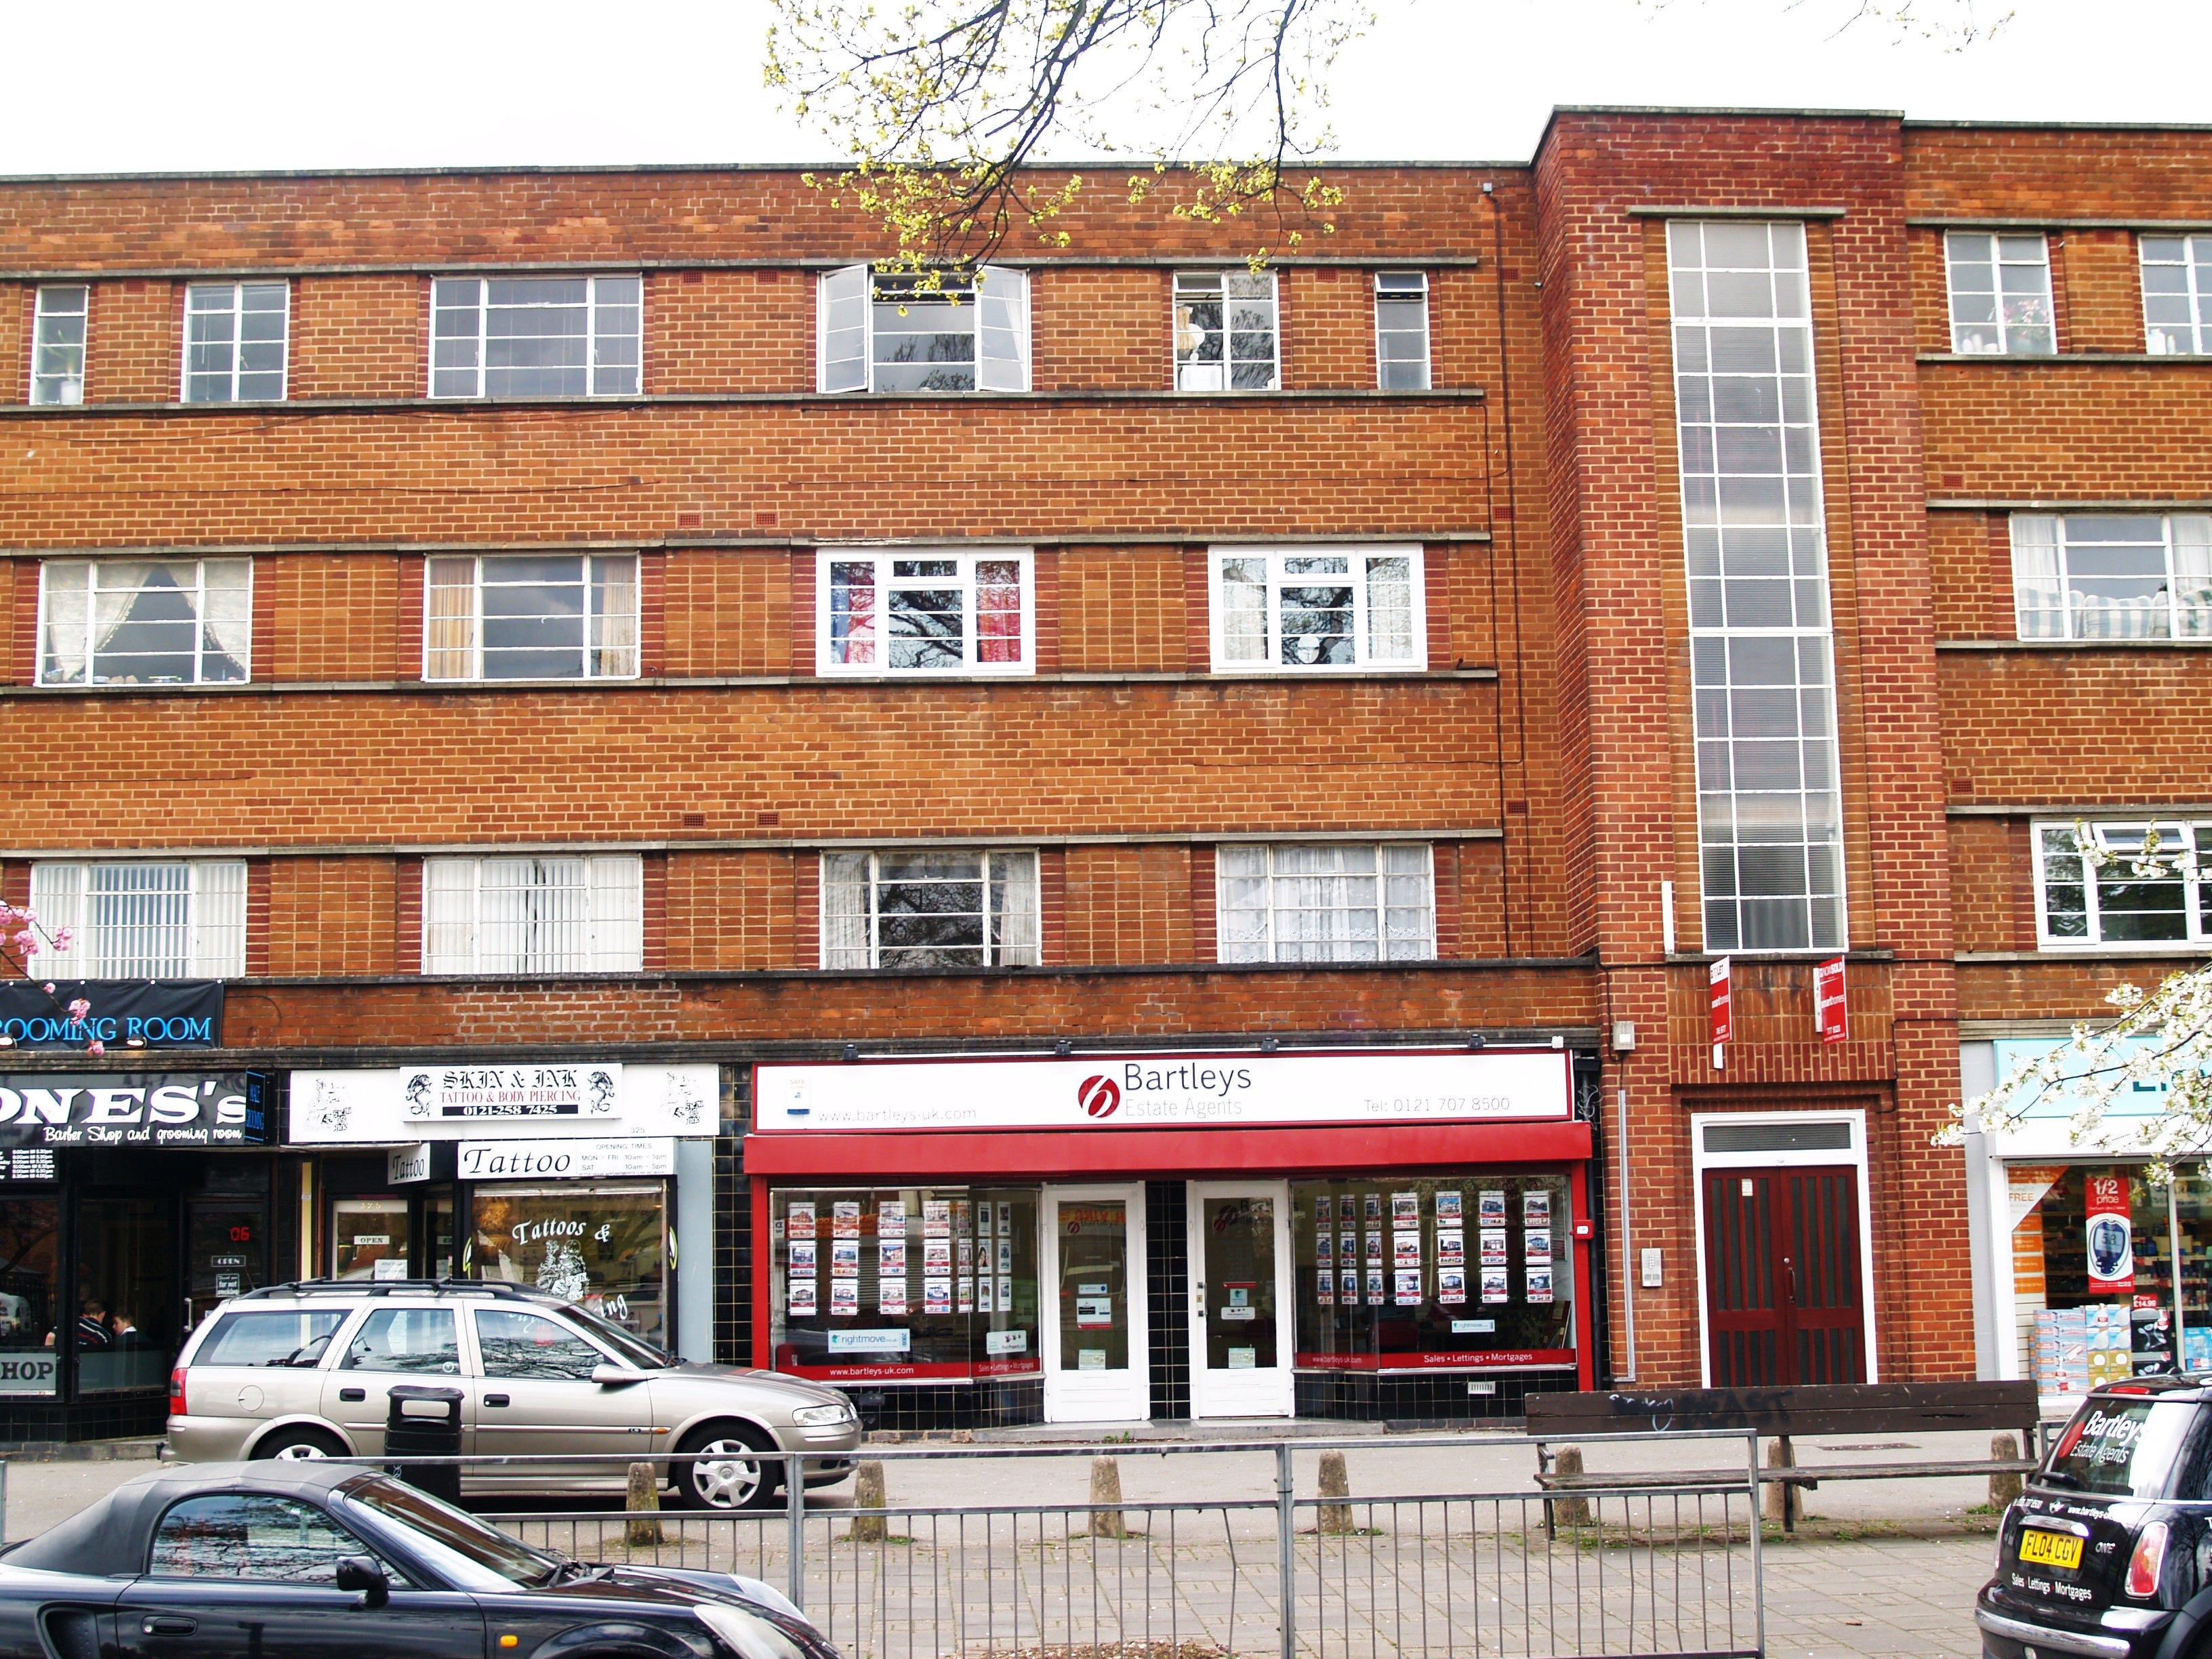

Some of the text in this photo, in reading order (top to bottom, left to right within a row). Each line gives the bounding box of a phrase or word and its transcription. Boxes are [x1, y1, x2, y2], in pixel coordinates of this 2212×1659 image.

[0, 1017, 211, 1041] OOMING ROOM
[443, 1069, 577, 1089] SKIN & INK
[1125, 1062, 1251, 1097] Bartleys
[441, 1090, 580, 1103] TATTOO & BODY PIERCING
[1364, 1097, 1509, 1111] Tel: 0121 707 8500
[464, 1105, 558, 1115] 0121-258 7425
[1126, 1098, 1242, 1118] Estate Agents
[43, 1126, 242, 1145] Barber Shop and grooming room
[393, 1155, 424, 1180] Tattoo
[464, 1148, 571, 1174] Tattoo
[2093, 1179, 2118, 1195] 1/2
[2009, 1193, 2034, 1202] FREE
[2096, 1195, 2119, 1205] price
[512, 1217, 611, 1245] Tattoos &
[1424, 1352, 1532, 1363] Sales Lettings Mortgages
[0, 1361, 54, 1380] HOP
[830, 1367, 914, 1376] www.bartleys-uk.com
[2082, 1410, 2145, 1446] Bartleys
[2070, 1440, 2129, 1463] Estate Agents
[2025, 1533, 2053, 1558] FL04
[2095, 1542, 2115, 1554] ONE
[2011, 1572, 2092, 1601] Sales Lettings Mortgages
